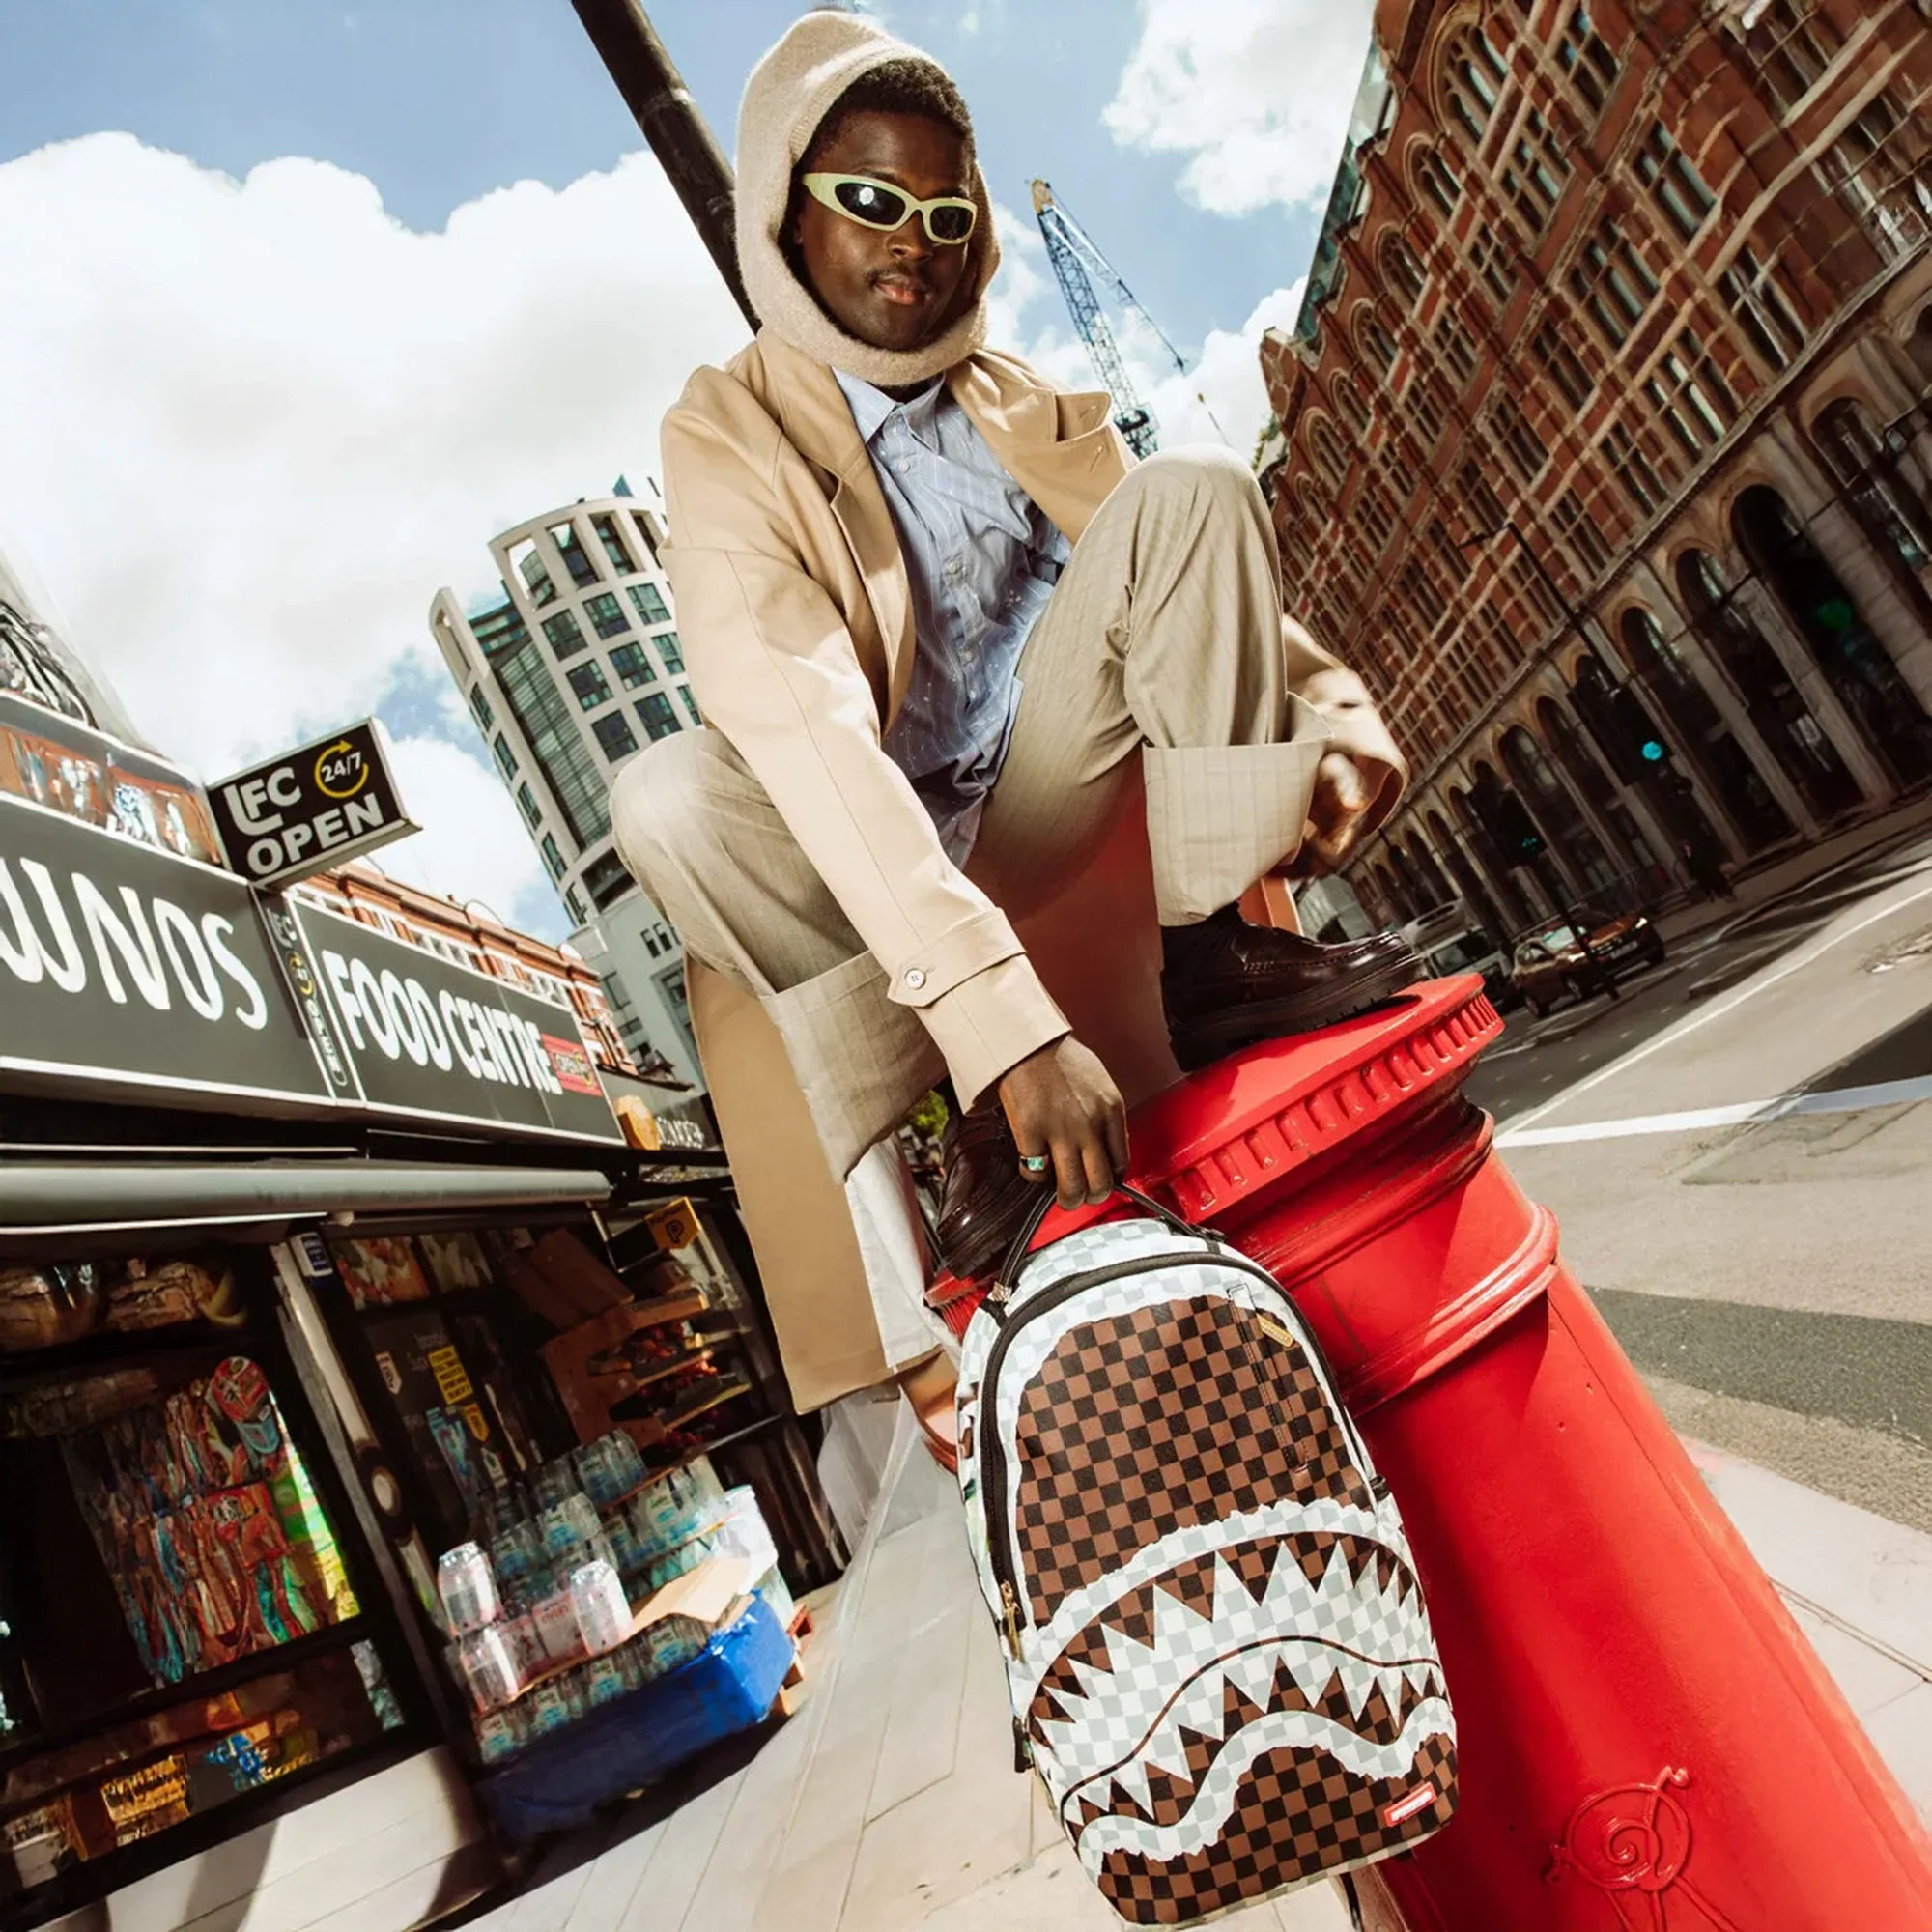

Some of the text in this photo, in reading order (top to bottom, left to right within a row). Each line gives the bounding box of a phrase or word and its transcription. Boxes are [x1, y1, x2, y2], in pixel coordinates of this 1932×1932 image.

[222, 766, 302, 837] LFC
[320, 751, 362, 783] 24/7
[246, 792, 384, 875] OPEN
[321, 949, 563, 1095] FOOD CENTRE
